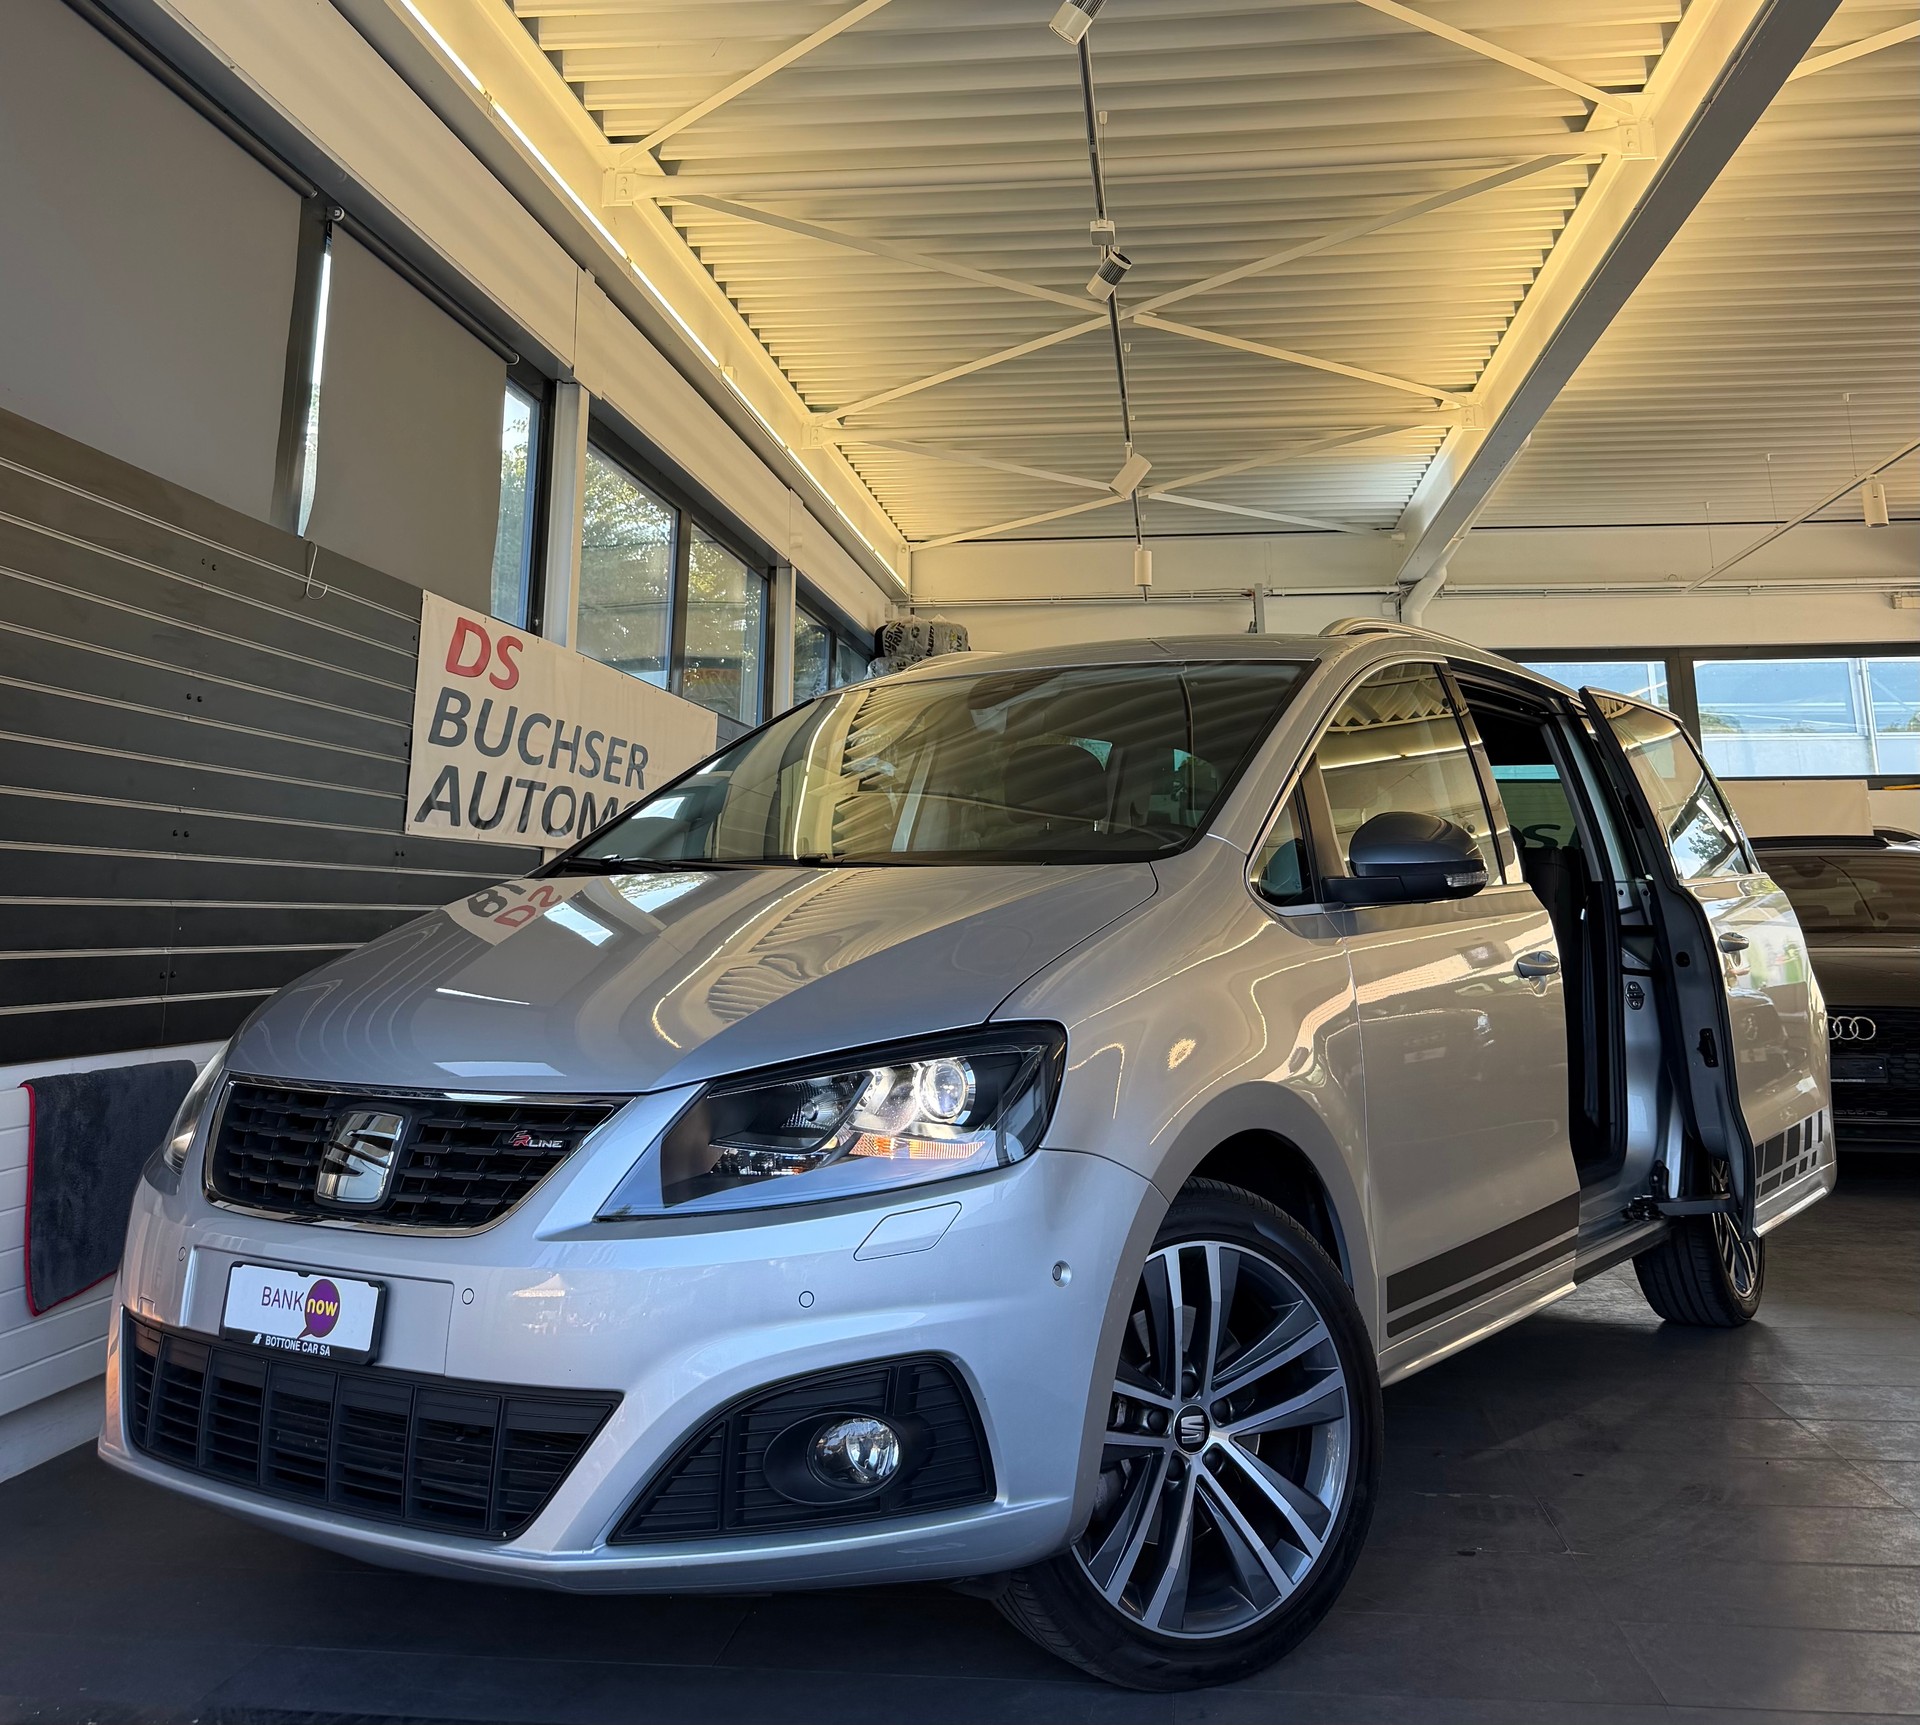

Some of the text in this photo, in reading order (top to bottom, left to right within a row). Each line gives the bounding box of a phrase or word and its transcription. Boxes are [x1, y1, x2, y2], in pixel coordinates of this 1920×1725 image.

[445, 617, 524, 690] DS
[428, 687, 649, 790] BUCHSER
[414, 764, 637, 840] AUTOM
[261, 1286, 338, 1317] BANK now
[265, 1335, 331, 1356] BOTTONE CAR SA
